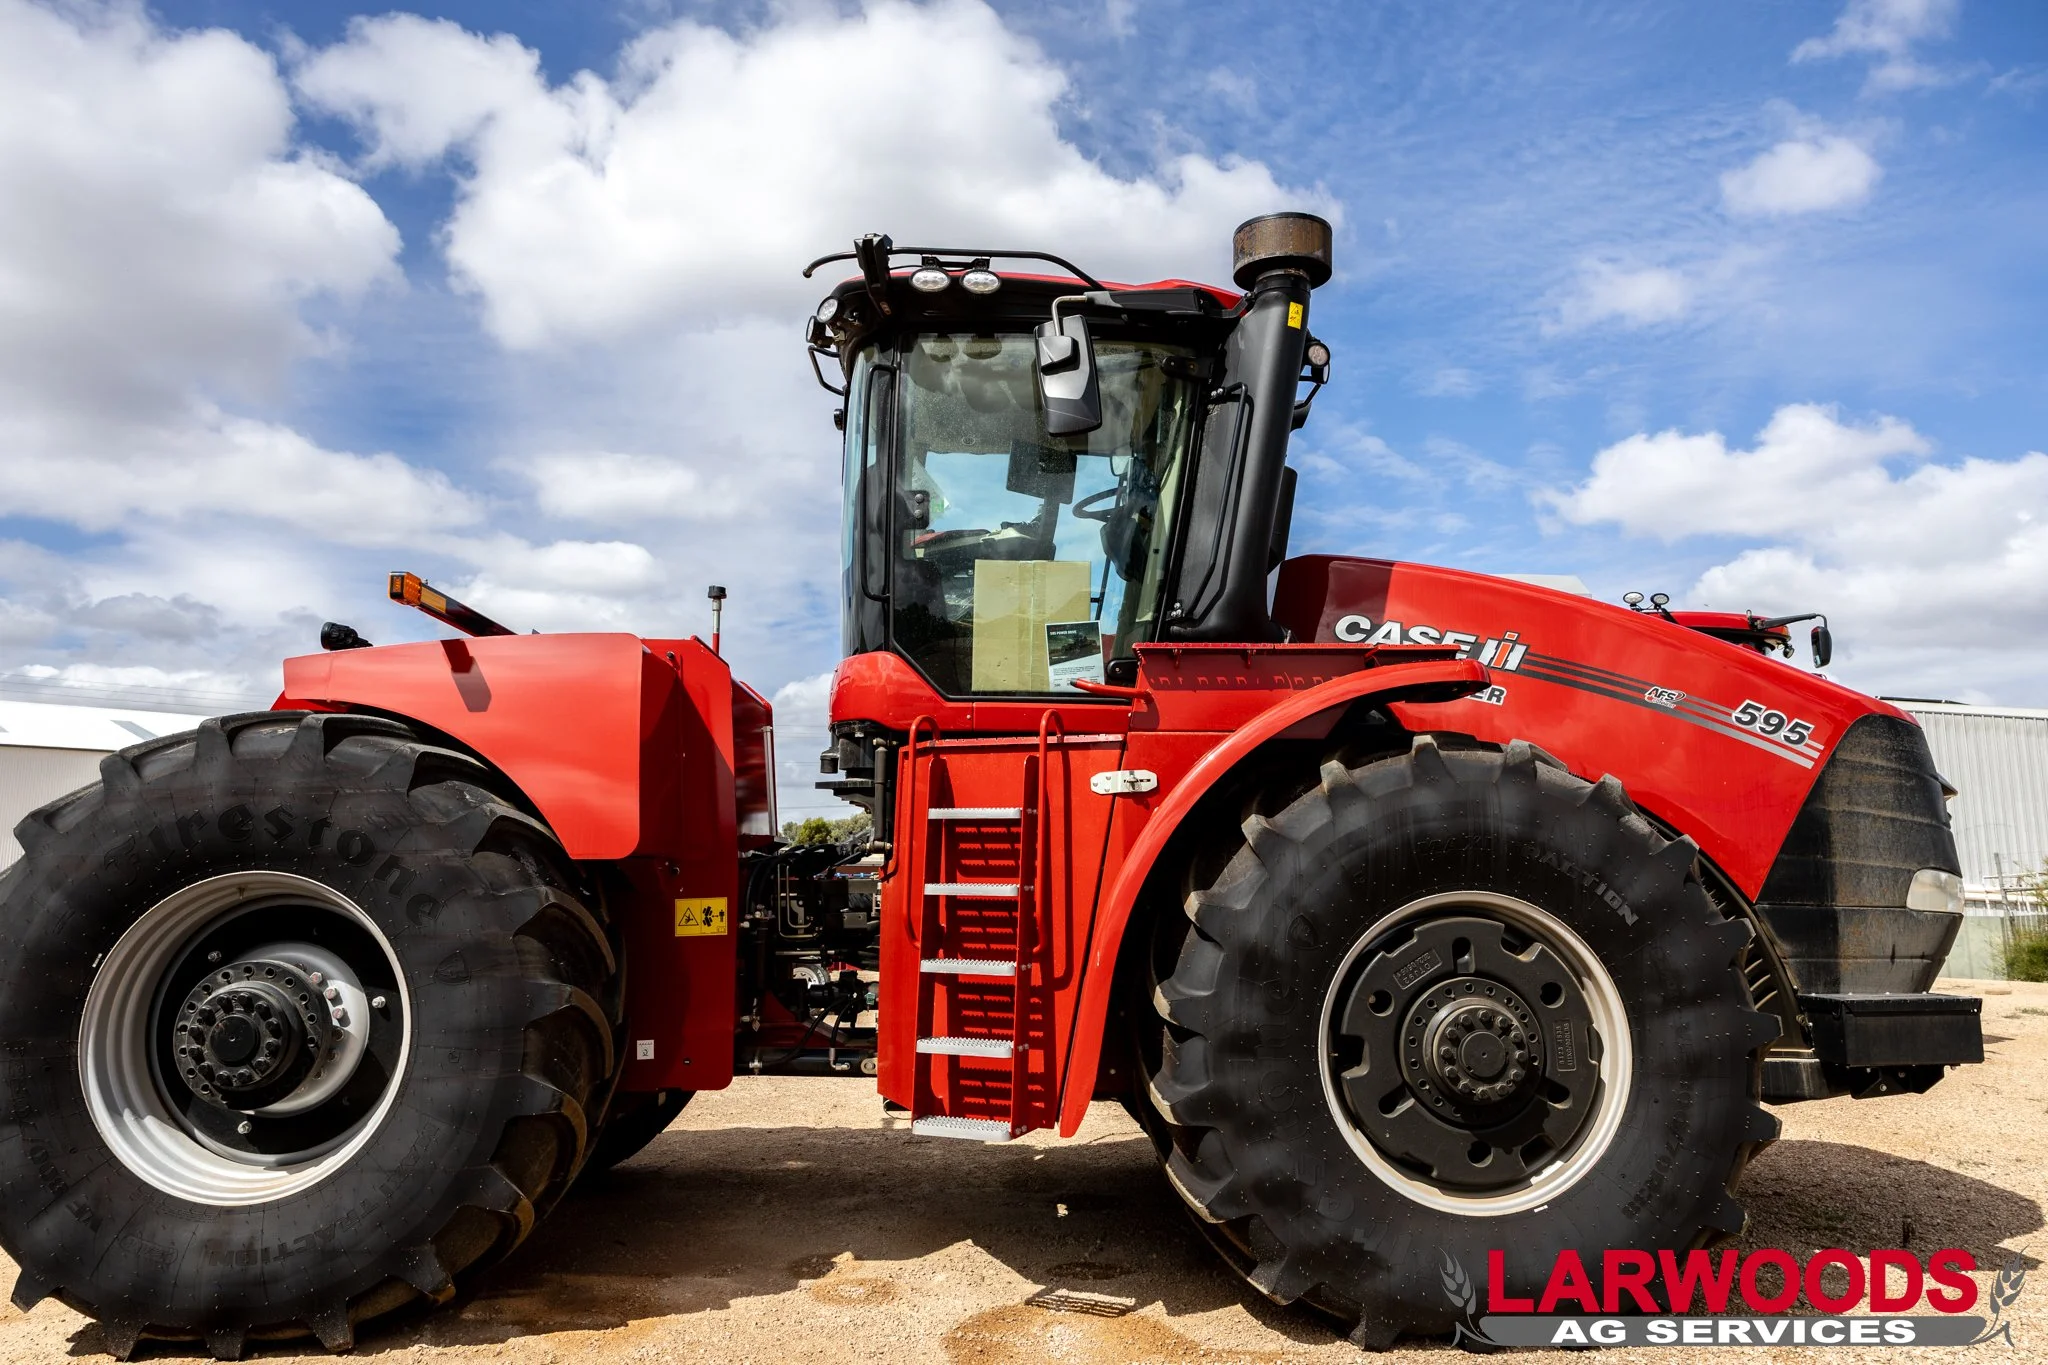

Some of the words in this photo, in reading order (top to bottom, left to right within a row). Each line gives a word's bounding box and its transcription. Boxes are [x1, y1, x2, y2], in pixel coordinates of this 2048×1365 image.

[1646, 686, 1678, 701] AFS
[1732, 699, 1815, 746] 595
[103, 803, 447, 927] Firestone
